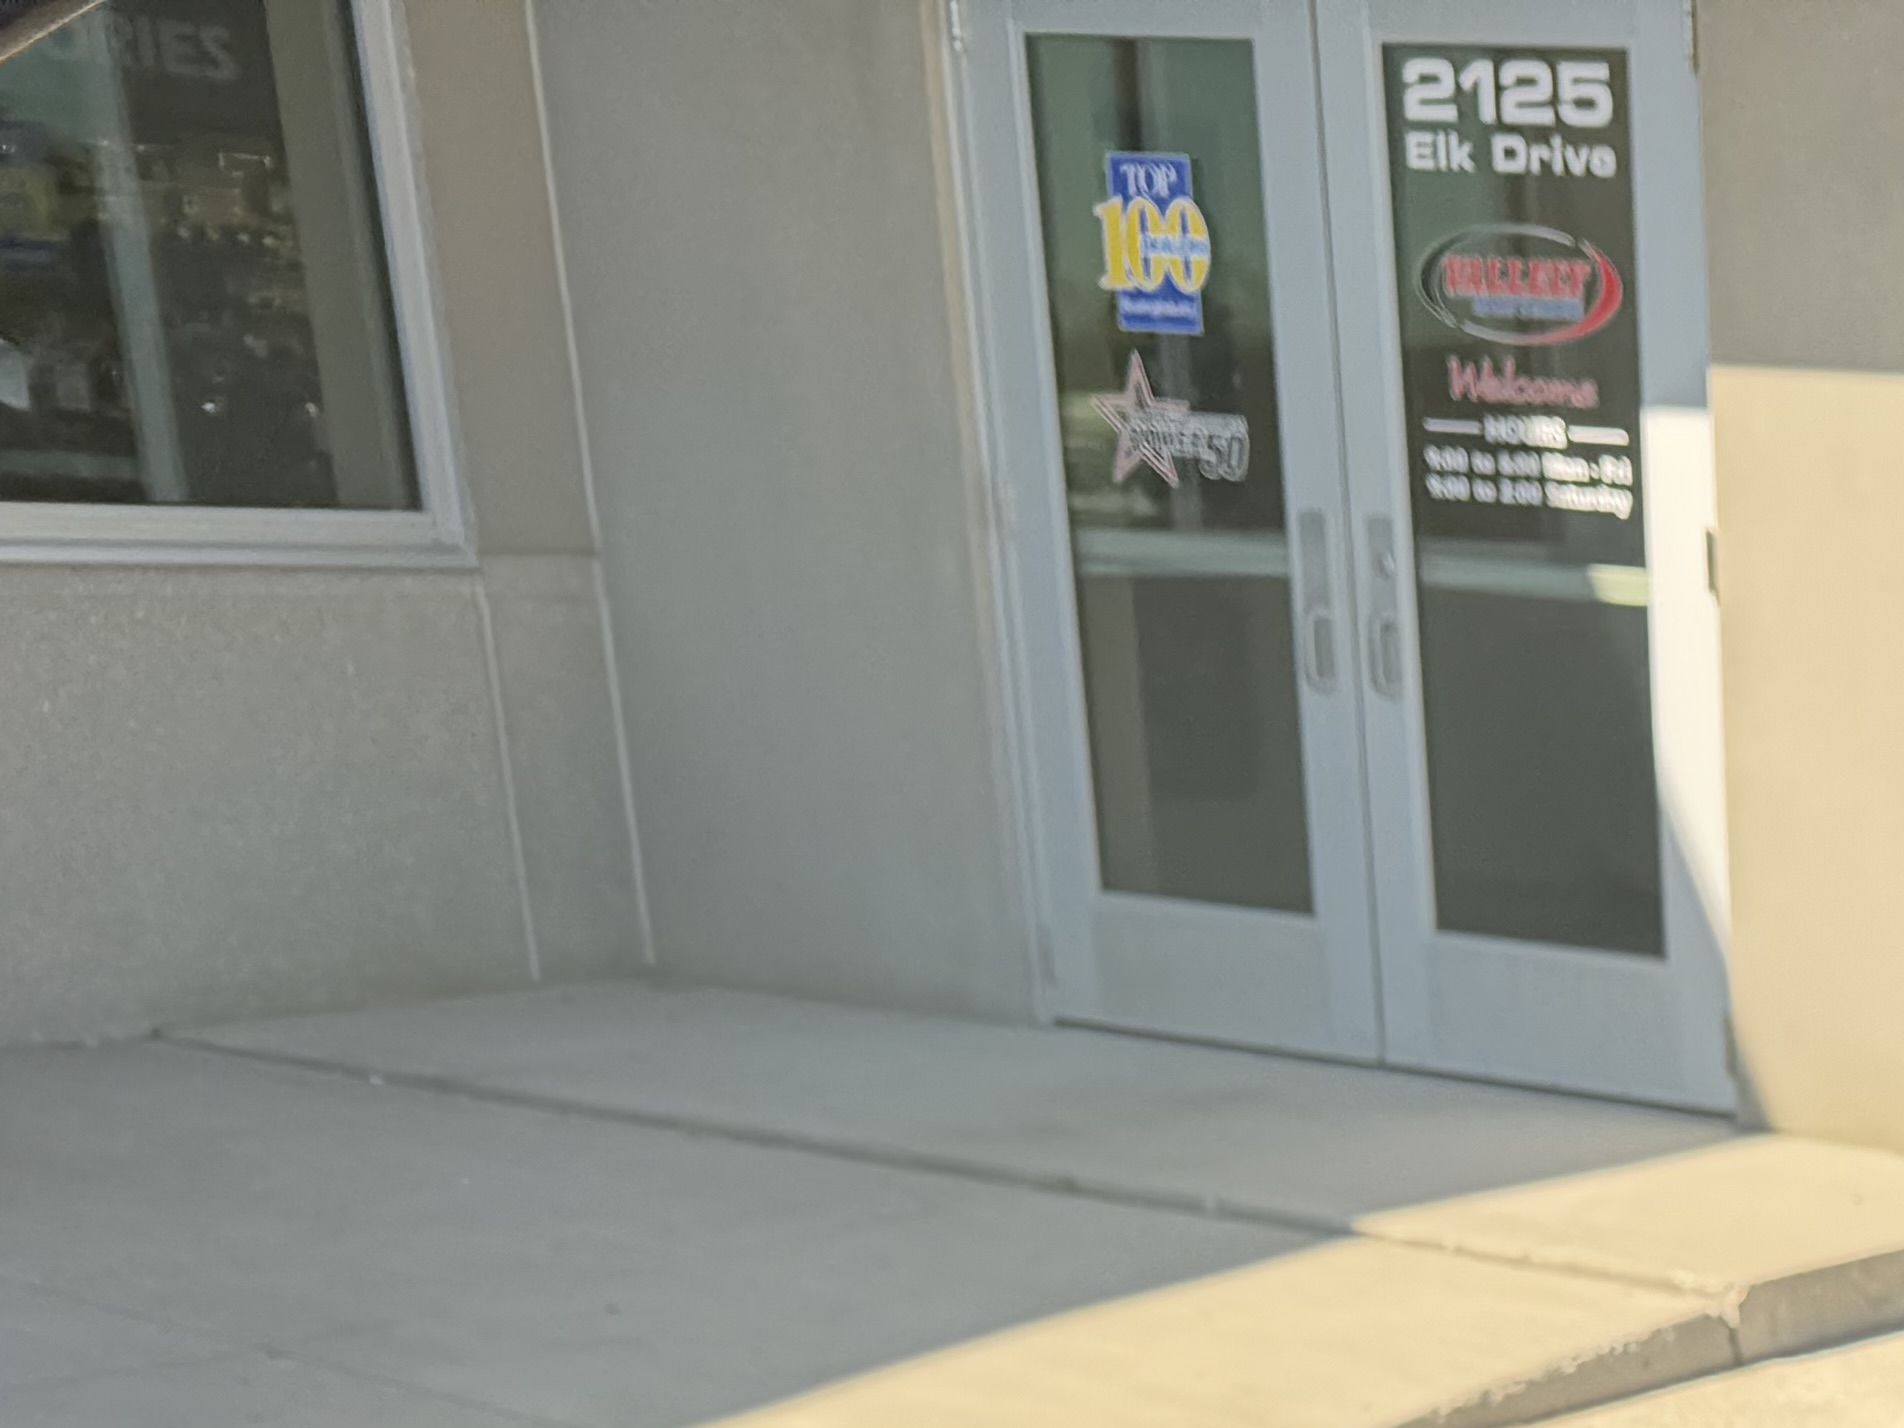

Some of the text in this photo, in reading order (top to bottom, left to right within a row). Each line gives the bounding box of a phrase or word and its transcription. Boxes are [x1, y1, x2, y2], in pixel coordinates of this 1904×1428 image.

[1403, 57, 1613, 128] 2125
[1120, 163, 1177, 198] TOP
[1405, 129, 1617, 178] Elk Drive
[1093, 196, 1211, 294] 100
[1446, 354, 1598, 409] Welcome
